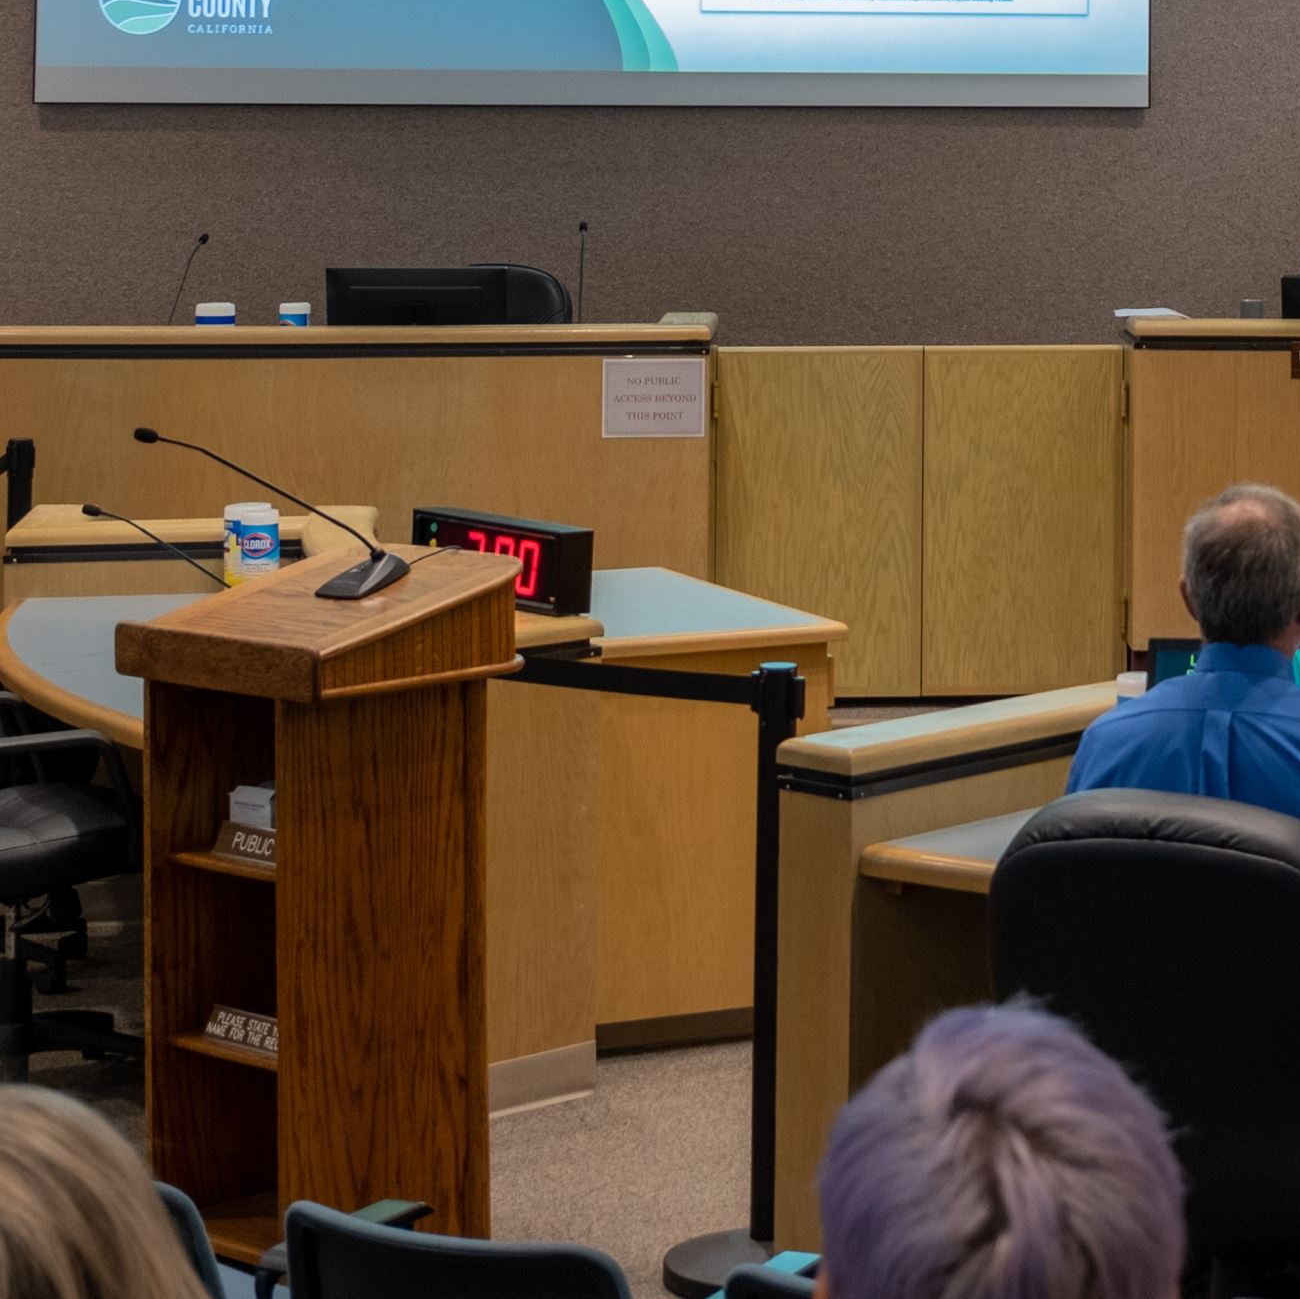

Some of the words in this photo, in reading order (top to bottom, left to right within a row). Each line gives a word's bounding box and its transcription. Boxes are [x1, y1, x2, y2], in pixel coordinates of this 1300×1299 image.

[187, 24, 273, 35] CALIFORNIA
[626, 376, 642, 386] NO
[644, 376, 682, 386] PUBLIC
[613, 394, 653, 403] ACCESS
[655, 393, 697, 403] BEYOND
[626, 411, 651, 421] THIS
[652, 411, 683, 421] POINT
[243, 539, 271, 550] CLOROX
[231, 831, 275, 856] PUBLIC
[216, 1011, 247, 1029] PLEASE
[246, 1018, 271, 1036] STATE
[204, 1021, 229, 1037] NAME
[228, 1027, 246, 1042] FOR
[246, 1031, 264, 1047] THE
